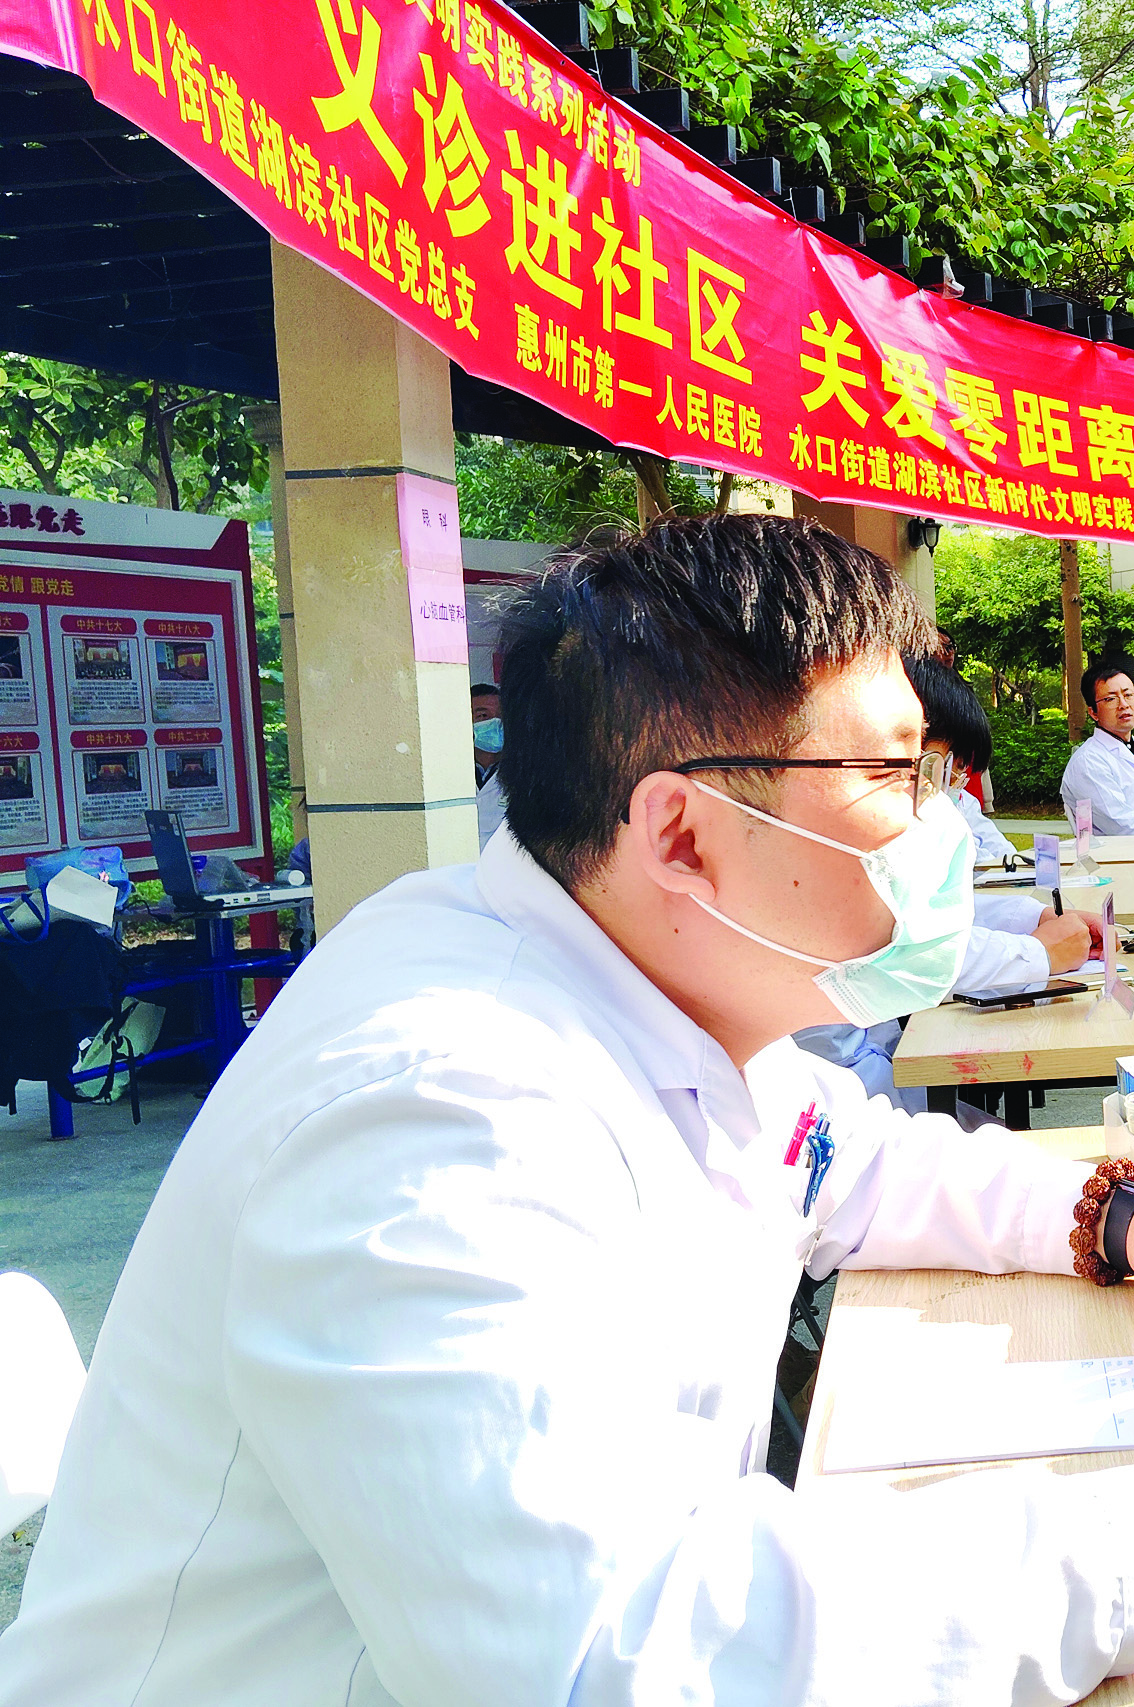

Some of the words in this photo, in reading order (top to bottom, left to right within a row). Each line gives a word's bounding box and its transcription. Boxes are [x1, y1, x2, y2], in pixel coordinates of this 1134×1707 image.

[514, 303, 763, 458] 惠州市第一人民医院
[31, 577, 75, 597] 跟党走
[76, 619, 123, 632] 中共十七大
[158, 622, 200, 635] 中共十八大
[86, 733, 133, 745] 中共十九大
[168, 731, 211, 742] 中共二十大
